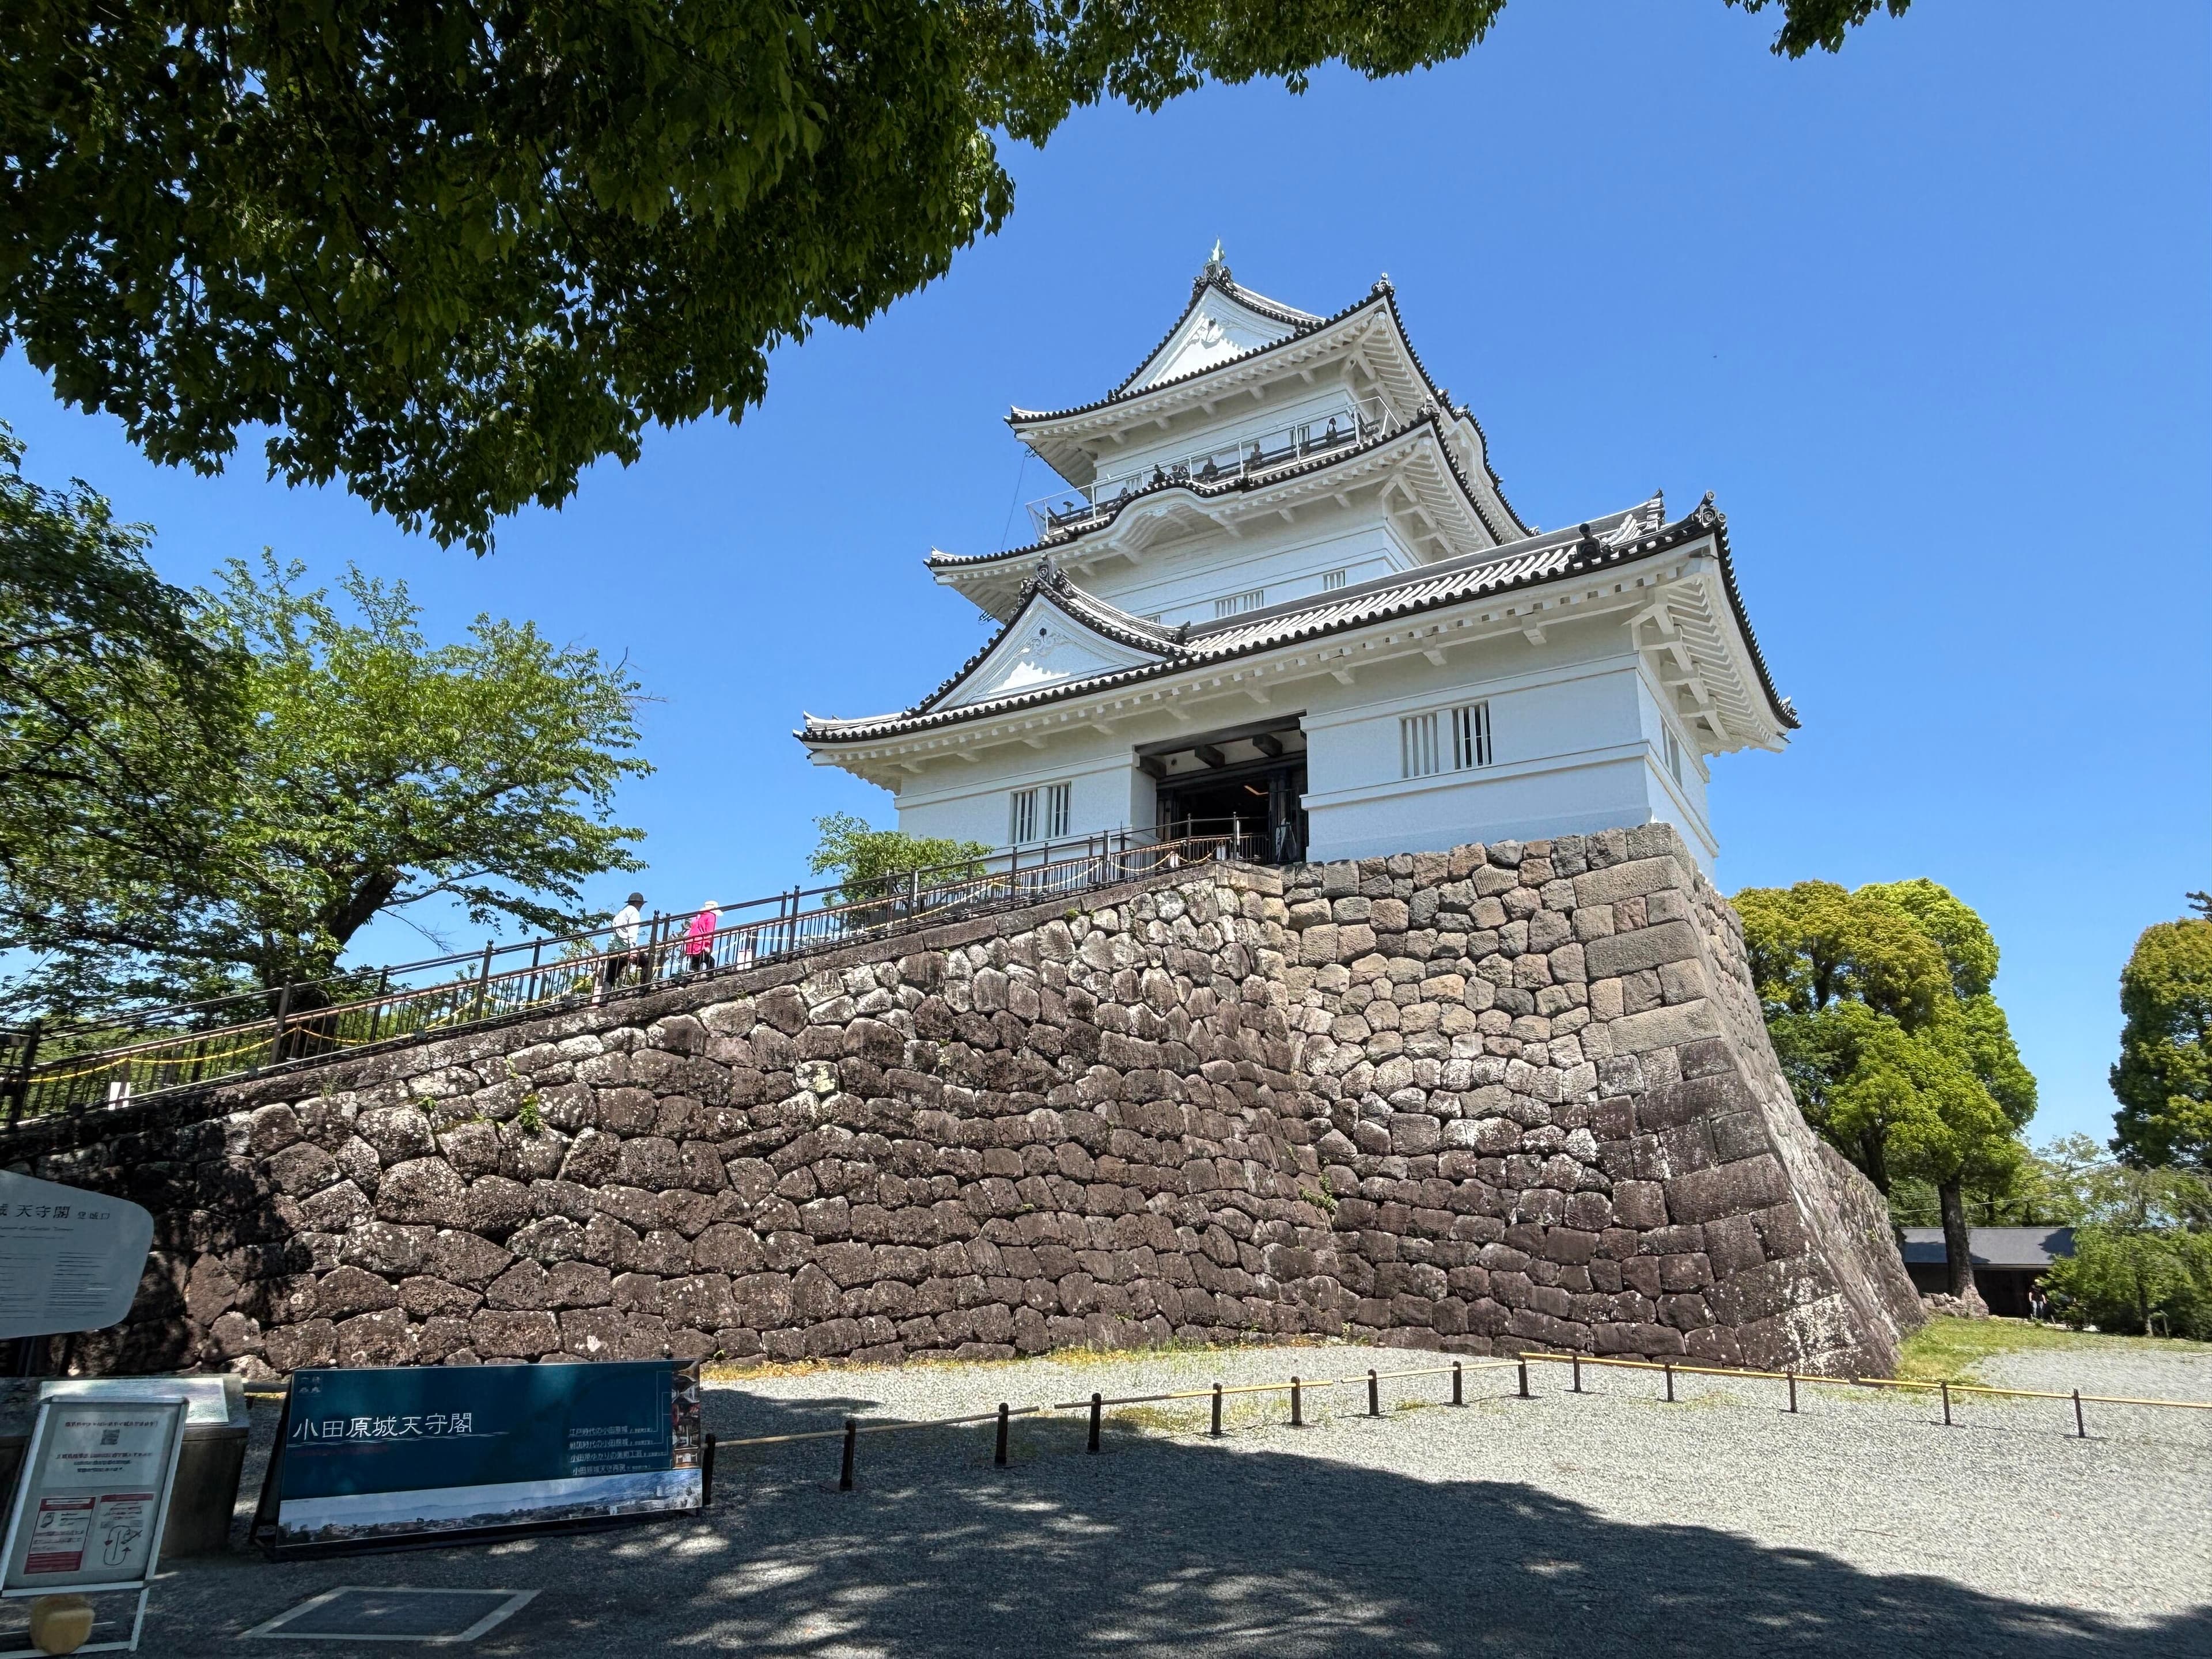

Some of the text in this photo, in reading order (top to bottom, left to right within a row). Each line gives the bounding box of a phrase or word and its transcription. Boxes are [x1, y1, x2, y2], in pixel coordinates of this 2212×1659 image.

[16, 1205, 71, 1219] 天守閣
[292, 1412, 472, 1441] 小田原城天守閣
